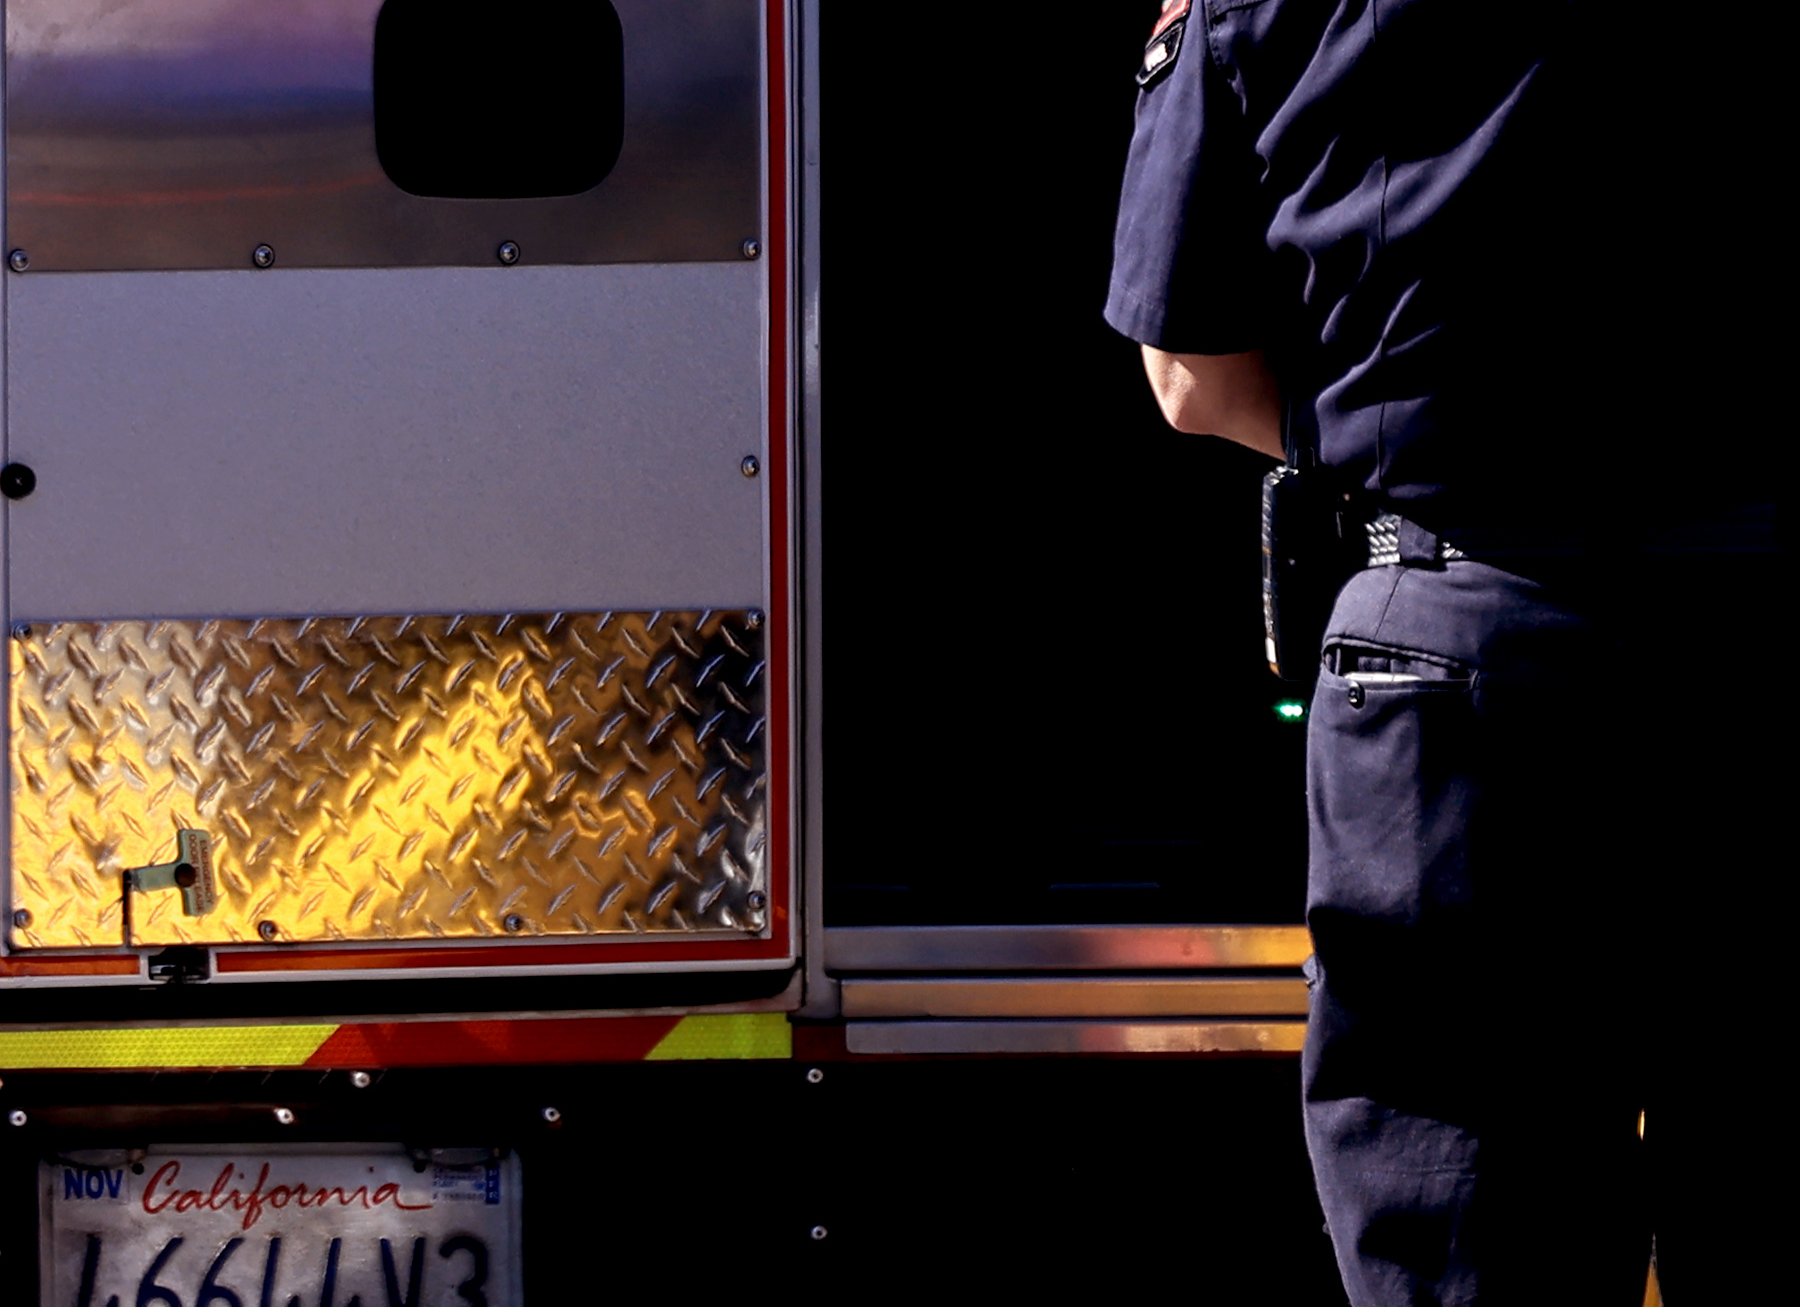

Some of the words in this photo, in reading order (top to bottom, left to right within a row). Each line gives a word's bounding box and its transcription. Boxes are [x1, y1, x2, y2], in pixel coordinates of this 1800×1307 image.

[200, 839, 214, 905] EMERGENCY
[64, 1168, 123, 1199] NOV
[143, 1160, 433, 1230] California
